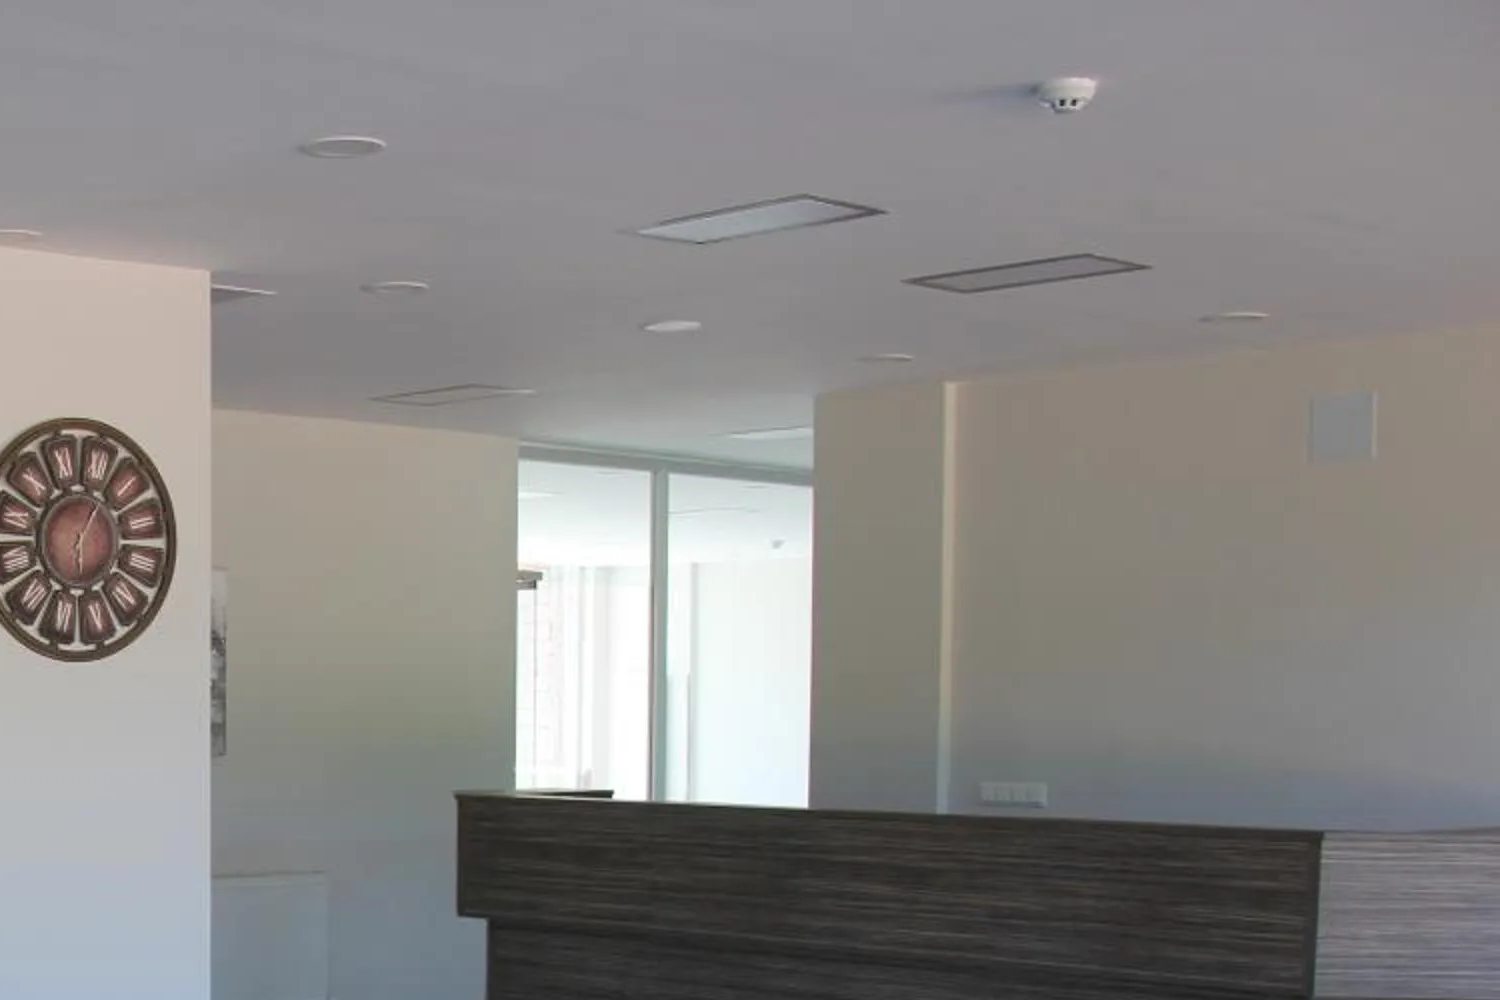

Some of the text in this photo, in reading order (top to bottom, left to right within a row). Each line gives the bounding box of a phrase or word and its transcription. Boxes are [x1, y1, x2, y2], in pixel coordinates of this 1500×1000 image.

[21, 467, 47, 497] X
[116, 475, 137, 497] I
[129, 516, 156, 530] II
[88, 600, 103, 632] V
